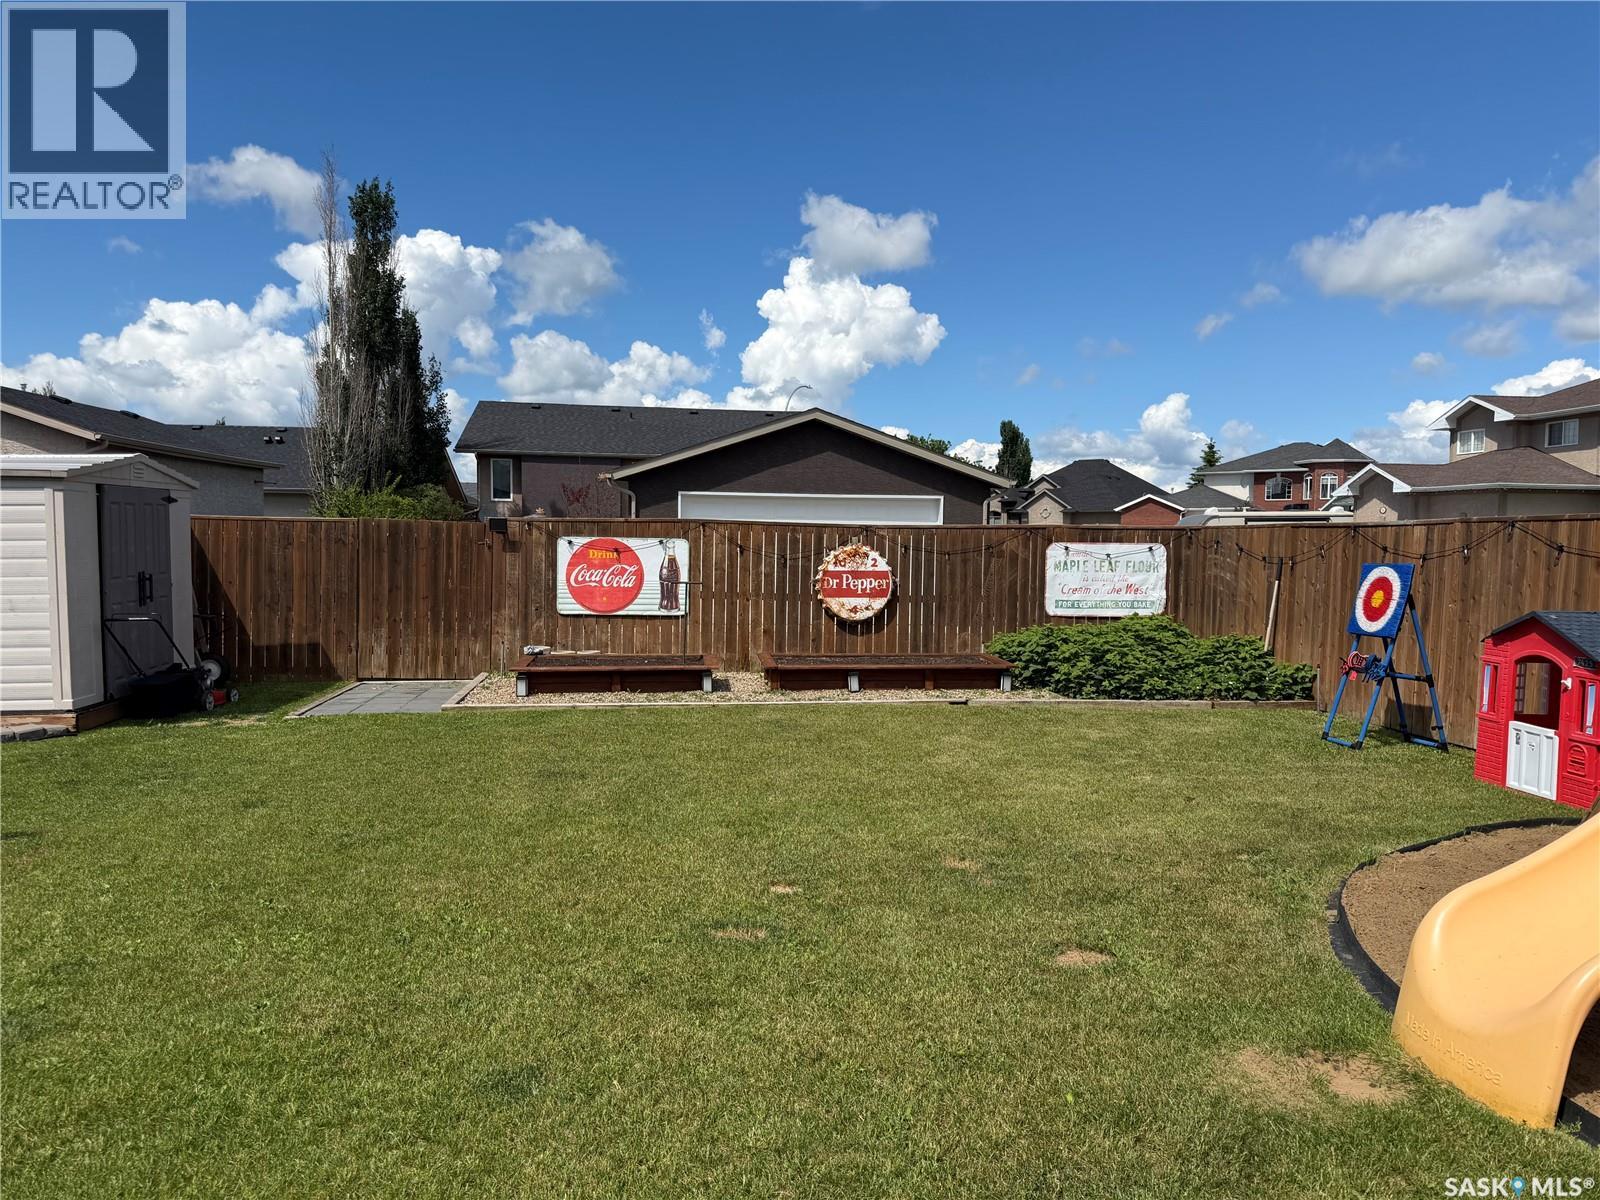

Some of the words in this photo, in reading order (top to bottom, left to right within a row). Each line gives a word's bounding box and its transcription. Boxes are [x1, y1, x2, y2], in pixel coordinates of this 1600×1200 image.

[871, 558, 878, 567] 2
[1054, 560, 1088, 573] MAPLE
[1094, 560, 1120, 573] LEAF
[823, 577, 839, 589] Dr
[841, 573, 889, 594] Pepper
[1058, 600, 1072, 608] FOR
[1074, 600, 1116, 608] EVERYTHING
[1118, 600, 1132, 608] YOU
[1133, 600, 1152, 608] BAKE
